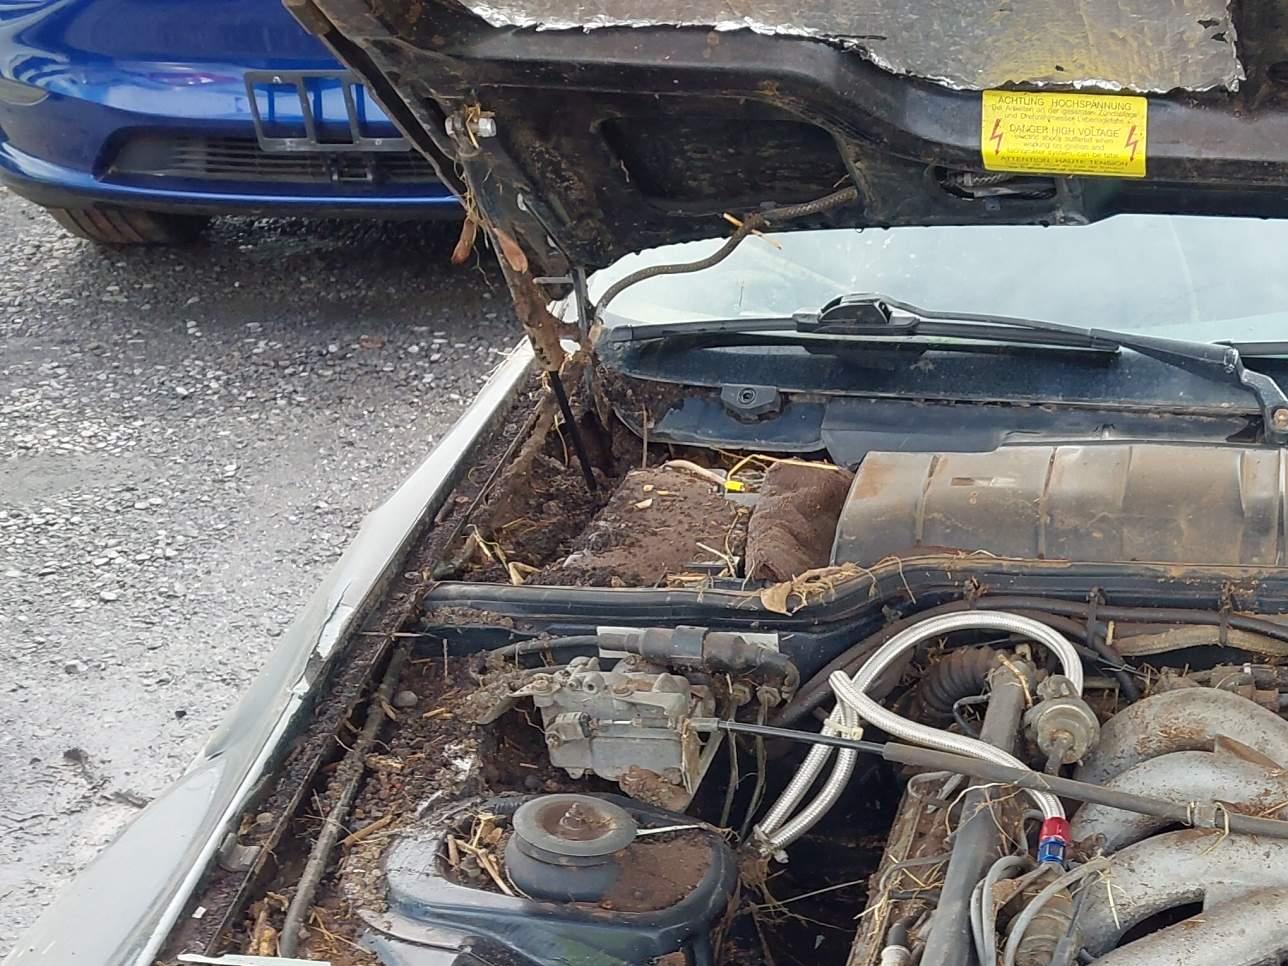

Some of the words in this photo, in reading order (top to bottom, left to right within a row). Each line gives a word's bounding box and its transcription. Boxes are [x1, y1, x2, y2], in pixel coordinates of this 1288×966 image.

[998, 96, 1045, 106] ACHTUNG
[1052, 98, 1132, 111] HOCHSPANNUNG
[1009, 124, 1049, 134] DANGER
[1052, 126, 1075, 136] HIGH
[1078, 127, 1120, 138] VOLTAGE
